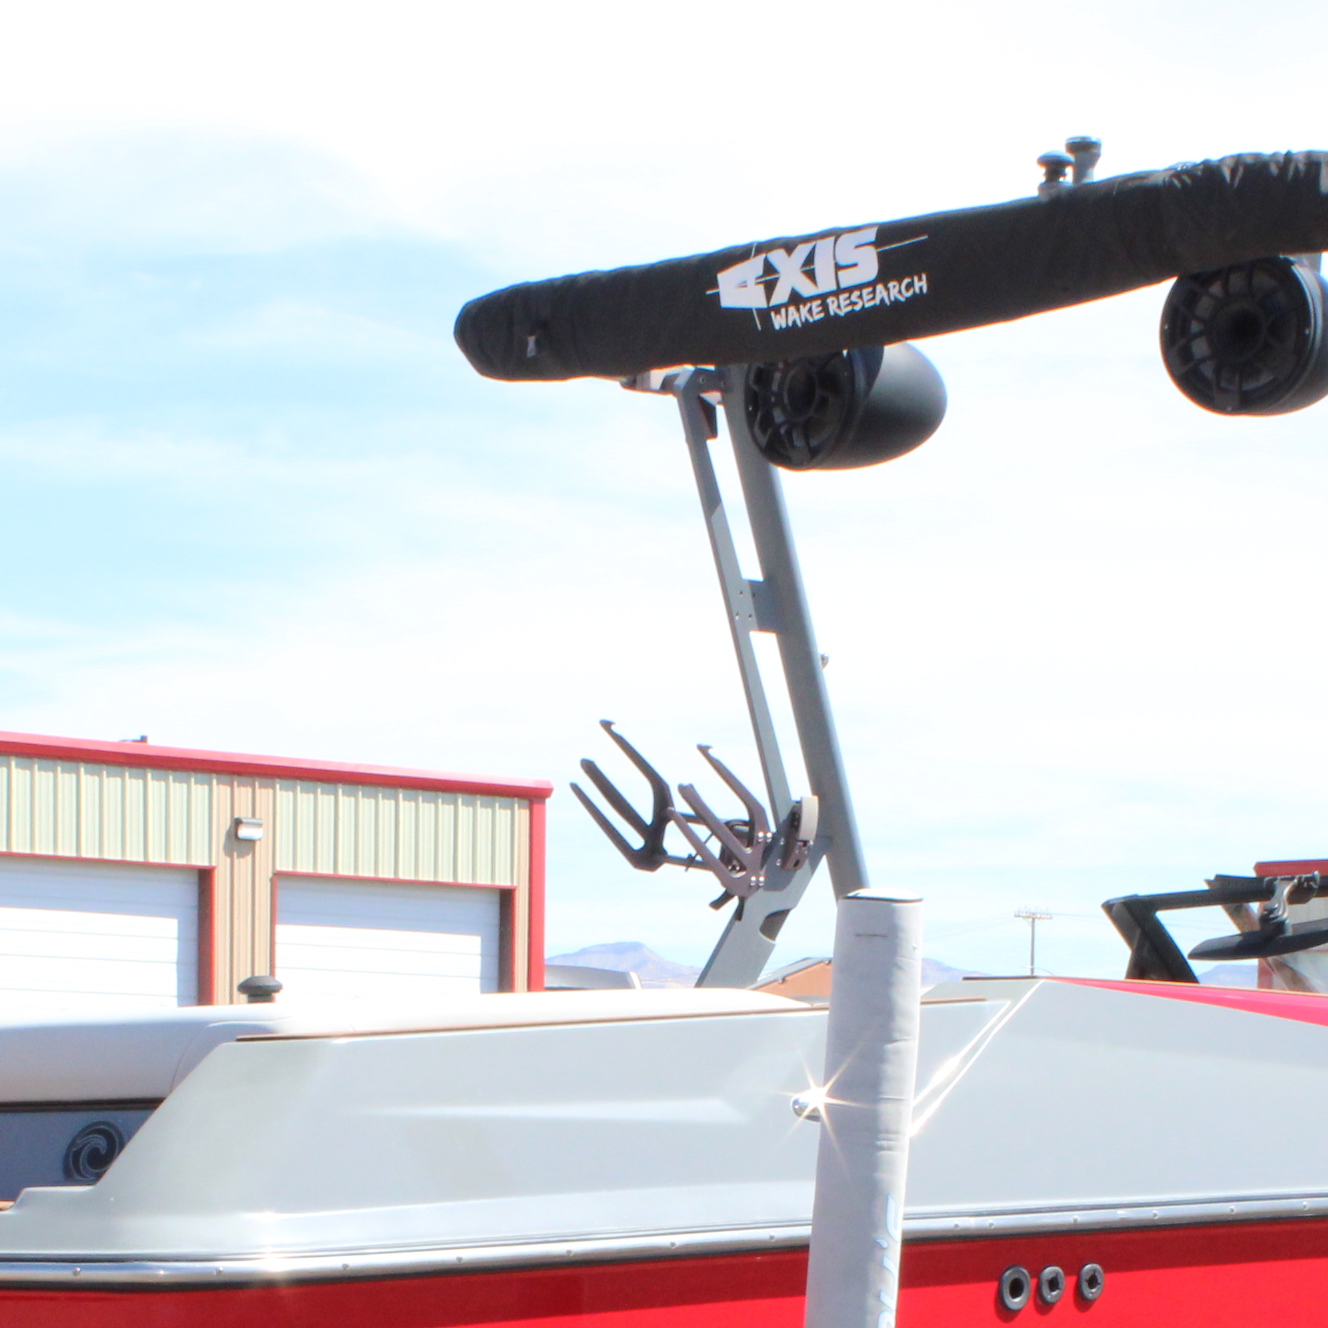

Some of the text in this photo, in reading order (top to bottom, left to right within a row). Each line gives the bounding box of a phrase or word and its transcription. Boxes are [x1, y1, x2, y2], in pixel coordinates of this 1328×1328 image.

[717, 226, 879, 309] AXIS
[770, 273, 928, 330] WAKE RESEARCH
